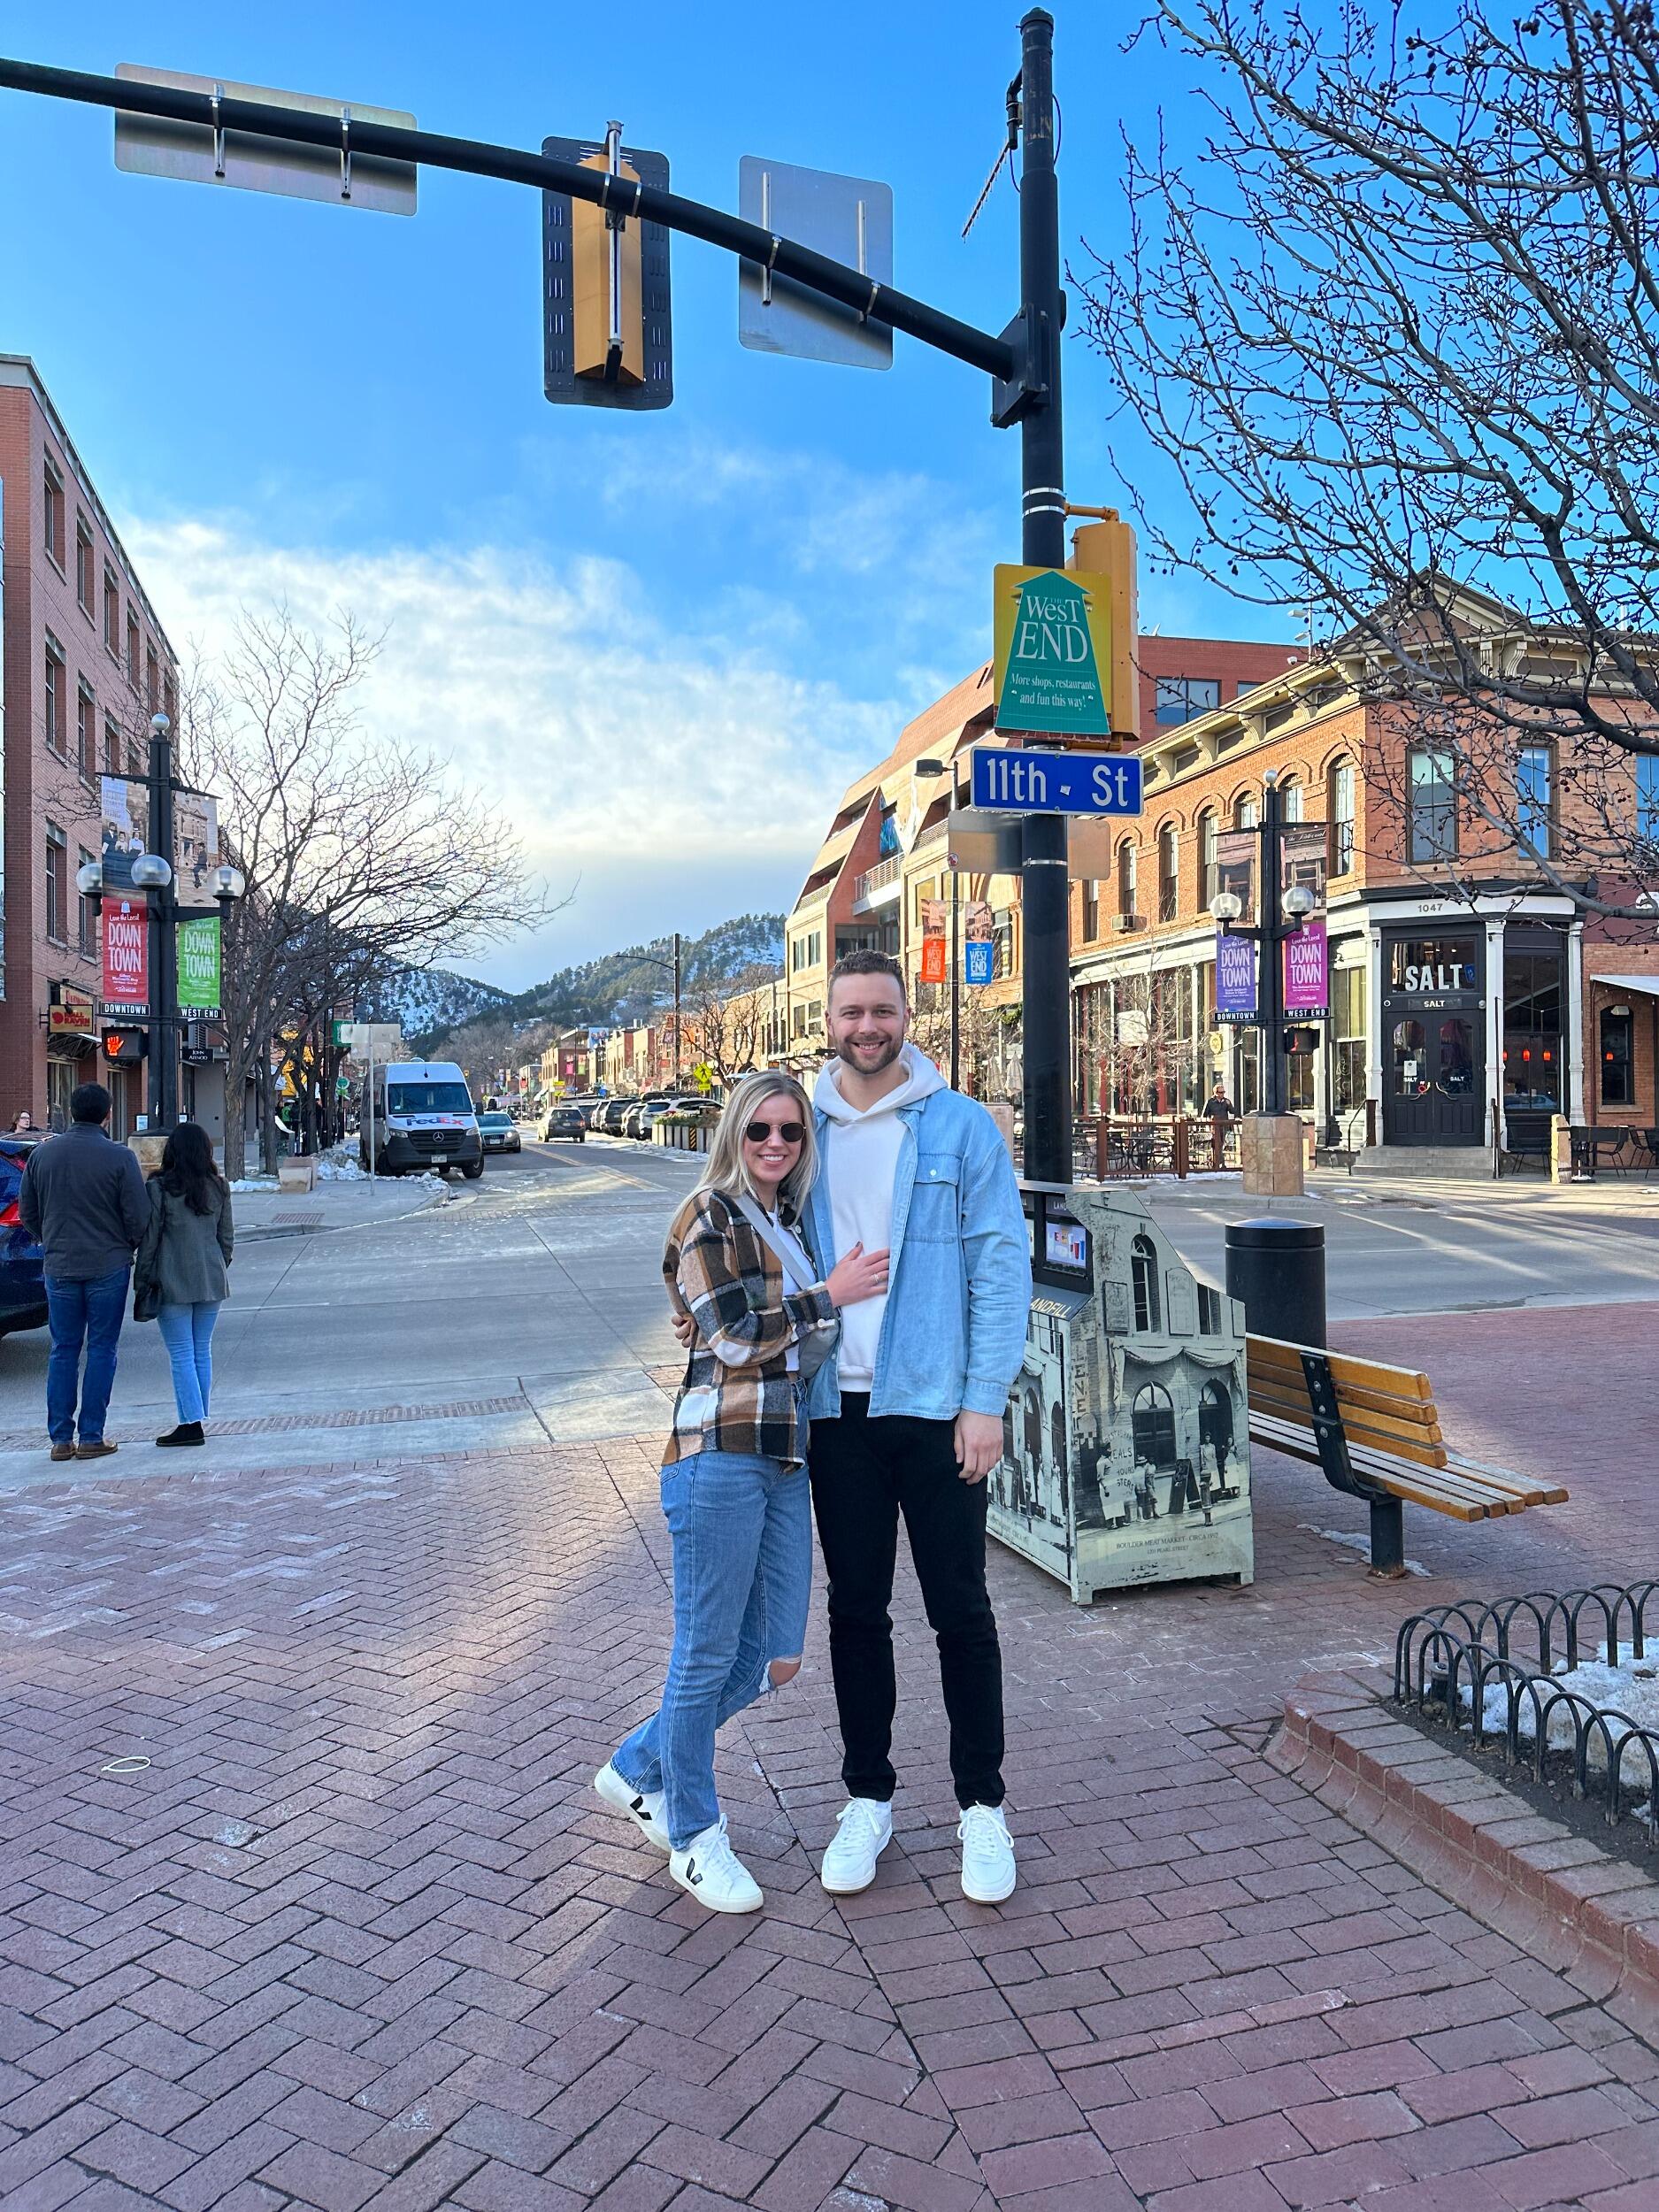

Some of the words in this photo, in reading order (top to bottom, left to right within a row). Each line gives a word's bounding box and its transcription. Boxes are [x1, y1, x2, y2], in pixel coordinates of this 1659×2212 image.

[1015, 621, 1088, 663] END
[1011, 673, 1030, 686] More
[1056, 680, 1096, 690] restaurants
[1019, 693, 1035, 704] and
[1036, 693, 1050, 706] fun
[1051, 694, 1066, 707] this
[1067, 695, 1087, 710] way!
[987, 757, 1047, 803] 11th
[1091, 764, 1129, 807] St
[1417, 902, 1443, 912] 1047
[108, 922, 142, 948] DOWN
[184, 932, 215, 954] DOWN
[108, 947, 142, 972] TOWN
[926, 949, 941, 959] WEST
[969, 951, 987, 962] WEST
[1221, 948, 1250, 967] DOWN
[1291, 943, 1322, 964] DOWN
[184, 954, 215, 979] TOWN
[926, 959, 941, 971] END
[971, 961, 987, 972] END
[1290, 964, 1322, 984] TOWN
[1221, 967, 1250, 987] TOWN
[1404, 964, 1463, 991] SALT
[104, 1004, 146, 1015] DOWNTOWN
[181, 1008, 201, 1018] WEST
[204, 1009, 219, 1018] END
[406, 1117, 464, 1125] FedEx
[1030, 1297, 1071, 1317] ANDFILL
[1112, 1448, 1133, 1460] EALS
[1117, 1540, 1143, 1549] BOULDER
[1161, 1536, 1185, 1545] MARKET
